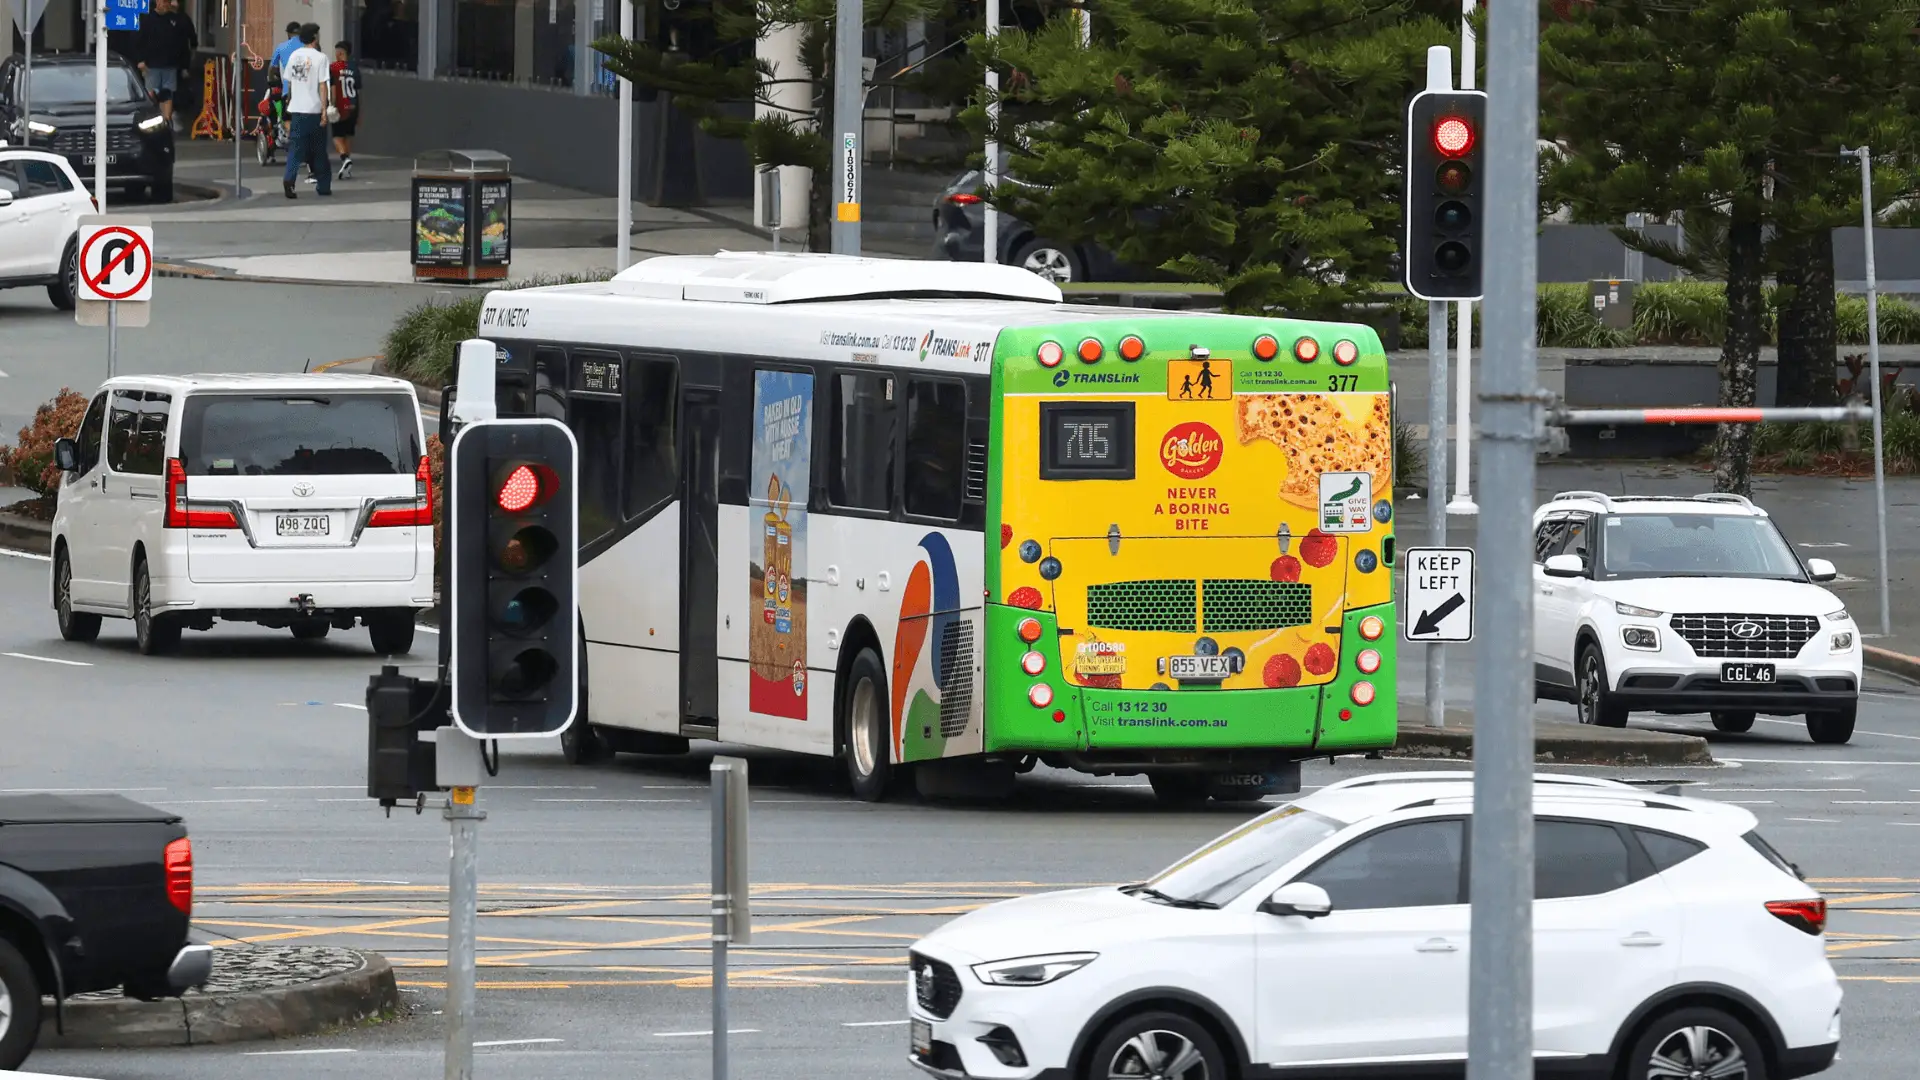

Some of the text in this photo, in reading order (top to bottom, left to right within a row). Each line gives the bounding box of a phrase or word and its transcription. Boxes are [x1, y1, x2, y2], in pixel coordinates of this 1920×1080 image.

[338, 76, 356, 98] 10
[484, 307, 530, 328] 377 KINETIC
[831, 332, 880, 348] translink.com.au
[908, 337, 916, 352] 30
[932, 338, 971, 358] TRANSLink
[974, 342, 990, 362] 377
[1073, 374, 1140, 384] TRANSLink
[1328, 375, 1358, 392] 377
[1063, 423, 1108, 458] 705
[1163, 431, 1219, 467] Golden
[1168, 488, 1216, 499] NEVER
[1154, 503, 1230, 514] A BORING
[1176, 519, 1208, 530] BITE
[1418, 556, 1461, 570] KEEP
[1420, 576, 1459, 590] LEFT
[1078, 655, 1124, 664] DO NOT OVERTAKE
[1079, 664, 1124, 673] TURNING VEHICLE
[1092, 701, 1167, 712] Call 13 12 30
[1092, 715, 1228, 728] Visit translink.com.au
